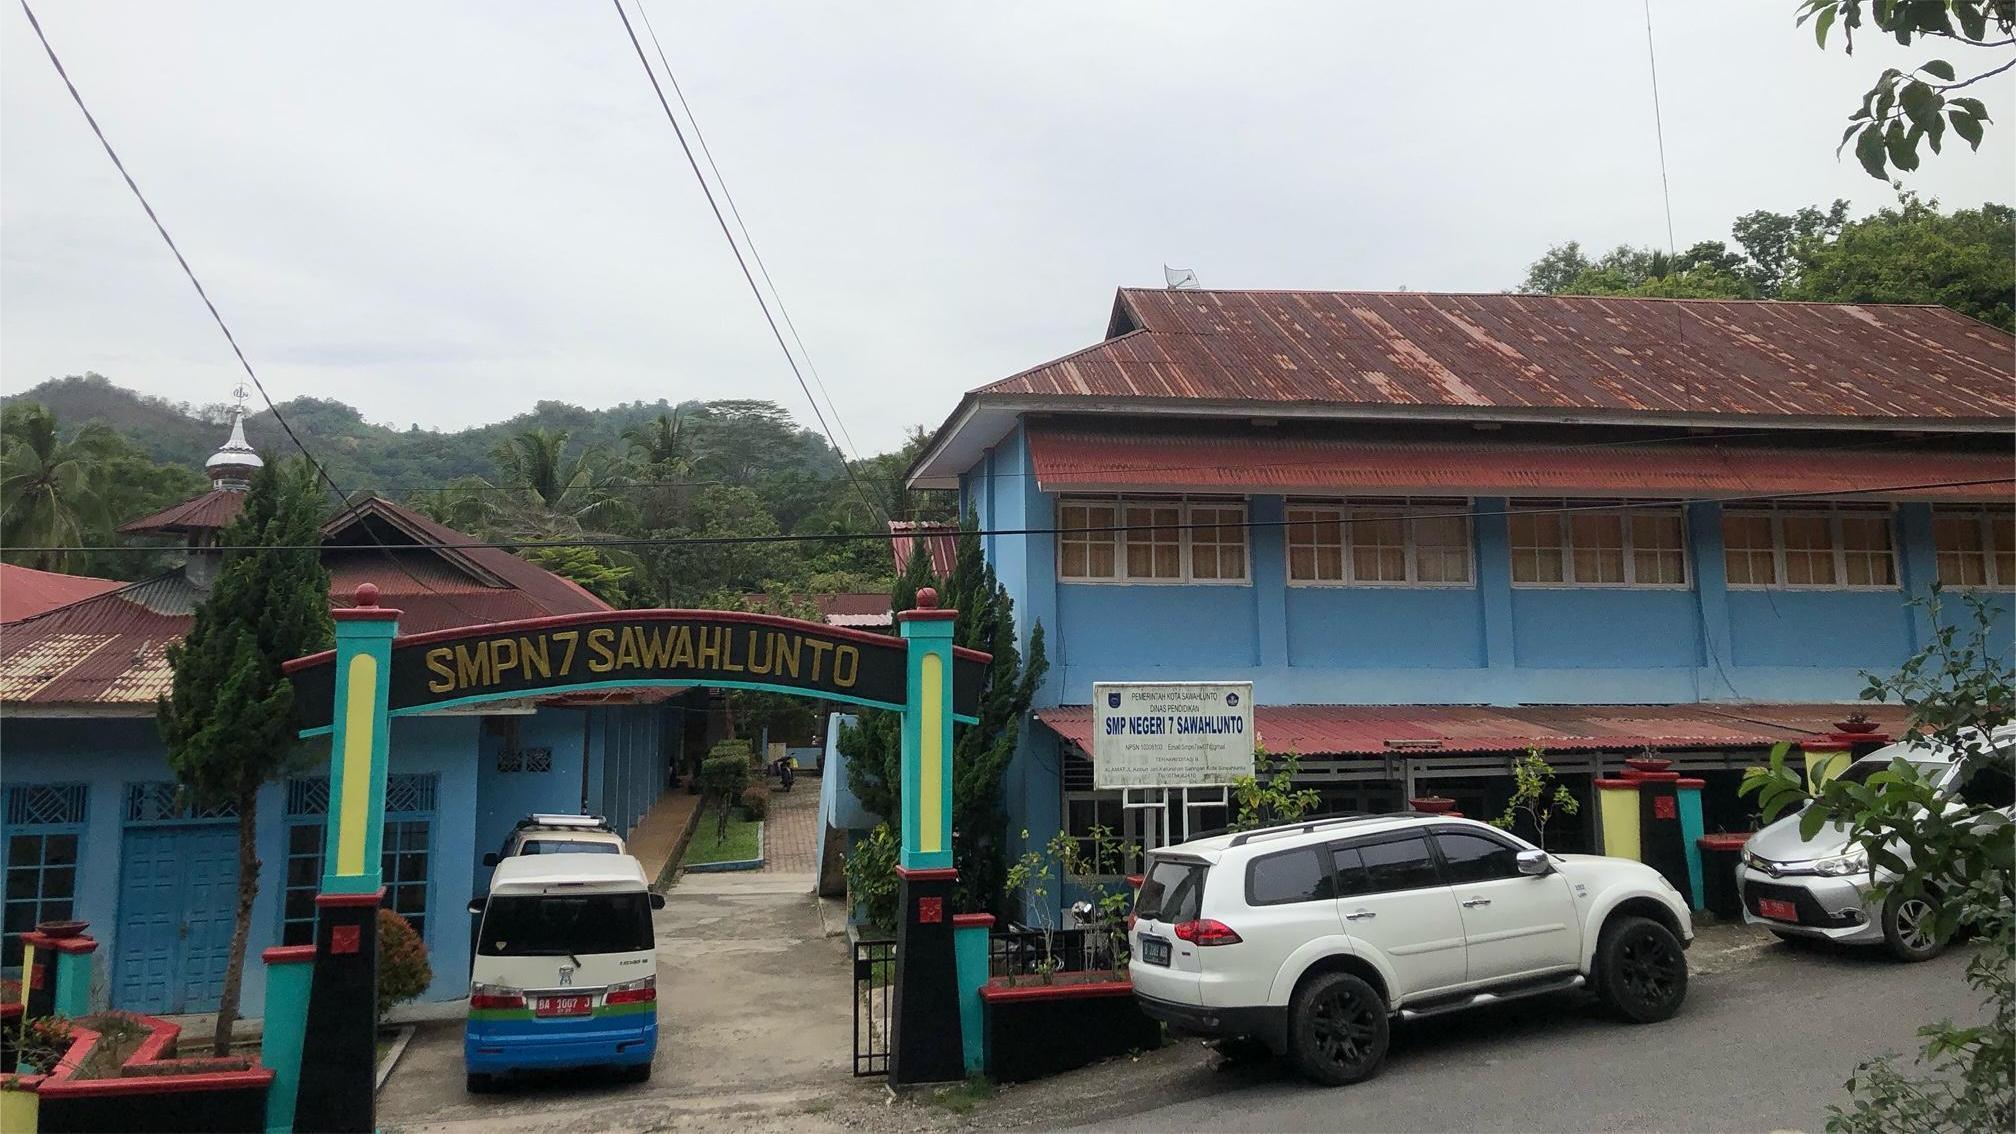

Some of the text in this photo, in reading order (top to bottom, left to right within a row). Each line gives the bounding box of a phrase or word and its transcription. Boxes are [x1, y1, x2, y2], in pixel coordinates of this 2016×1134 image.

[587, 625, 860, 687] SAWAHLUNTO
[1131, 692, 1217, 700] PEMERINTAH KOTA SAWAHLUNTO
[1150, 704, 1200, 712] DINAS PENDIDIKAN
[1105, 715, 1243, 735] SMP NEGERI 7 SAWAHLUNTO
[538, 999, 550, 1010] BA
[584, 997, 590, 1007] J
